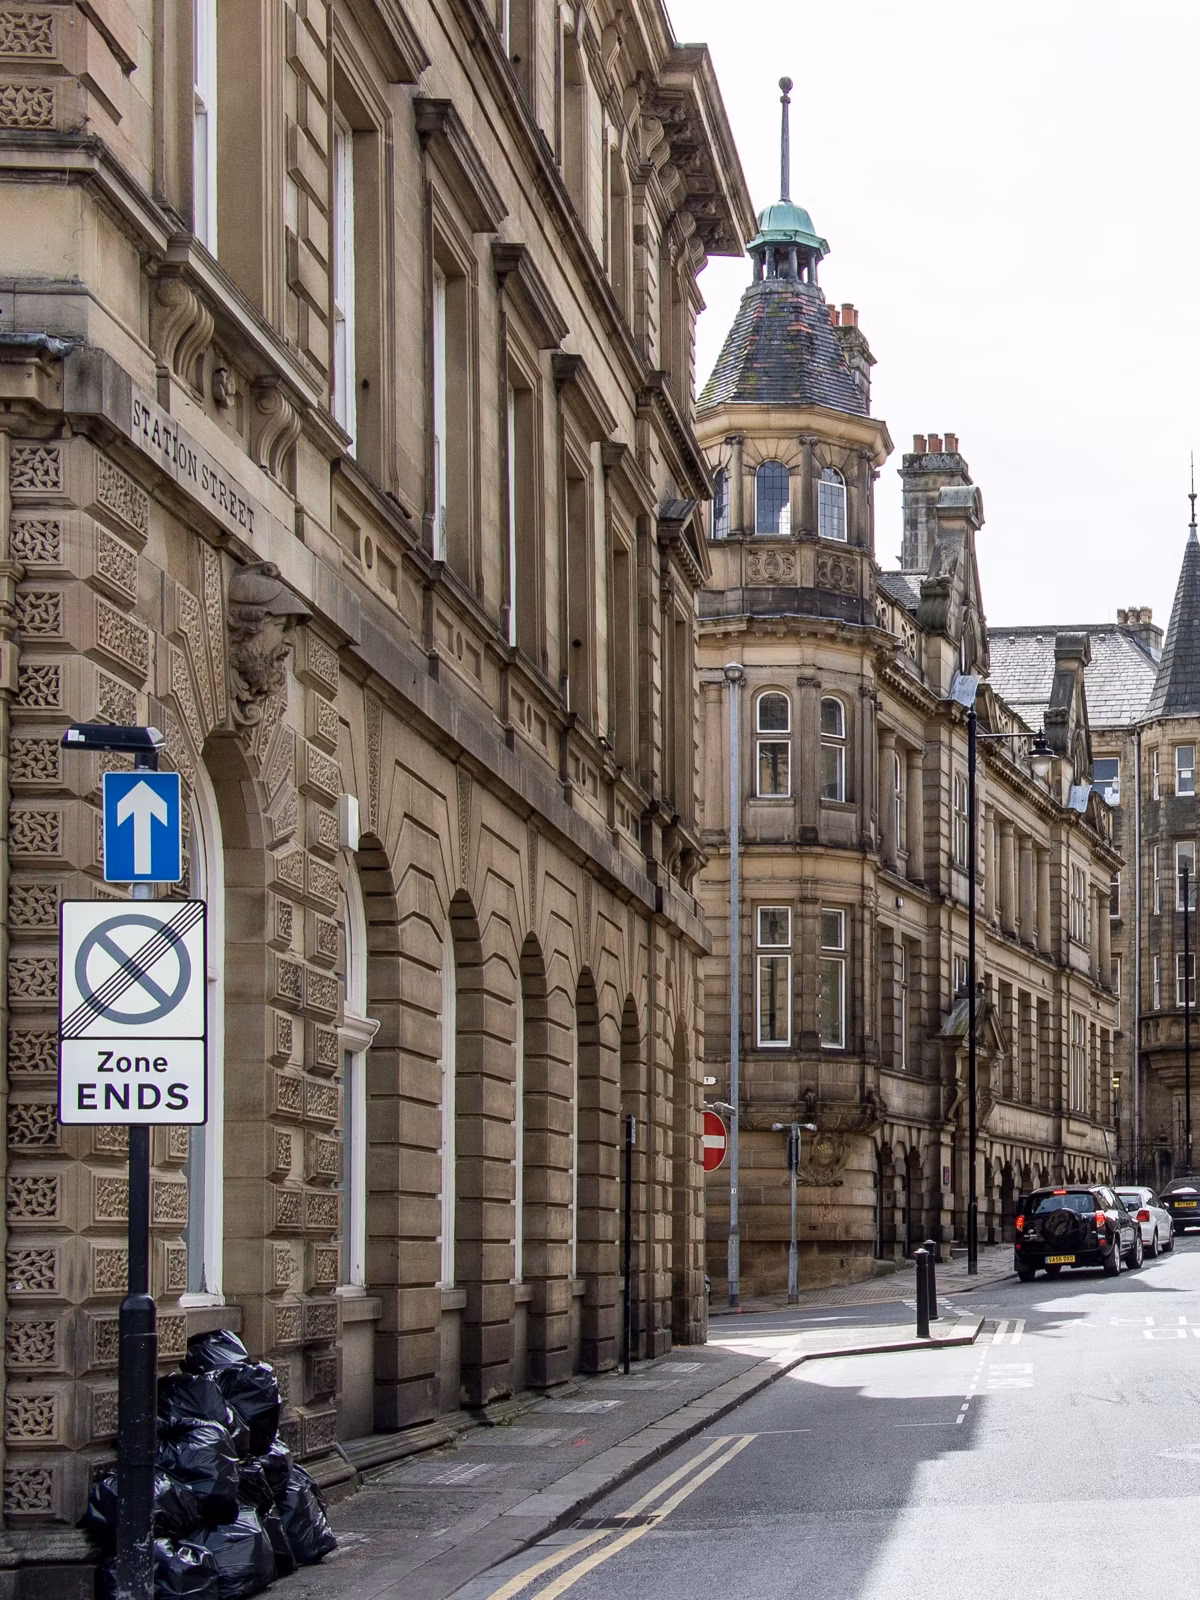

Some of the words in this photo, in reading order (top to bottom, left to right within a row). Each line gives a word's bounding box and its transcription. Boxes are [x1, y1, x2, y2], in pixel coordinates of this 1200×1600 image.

[133, 399, 197, 481] STATION
[201, 464, 254, 535] STREET
[97, 1051, 168, 1073] Zone
[77, 1083, 189, 1111] ENDS
